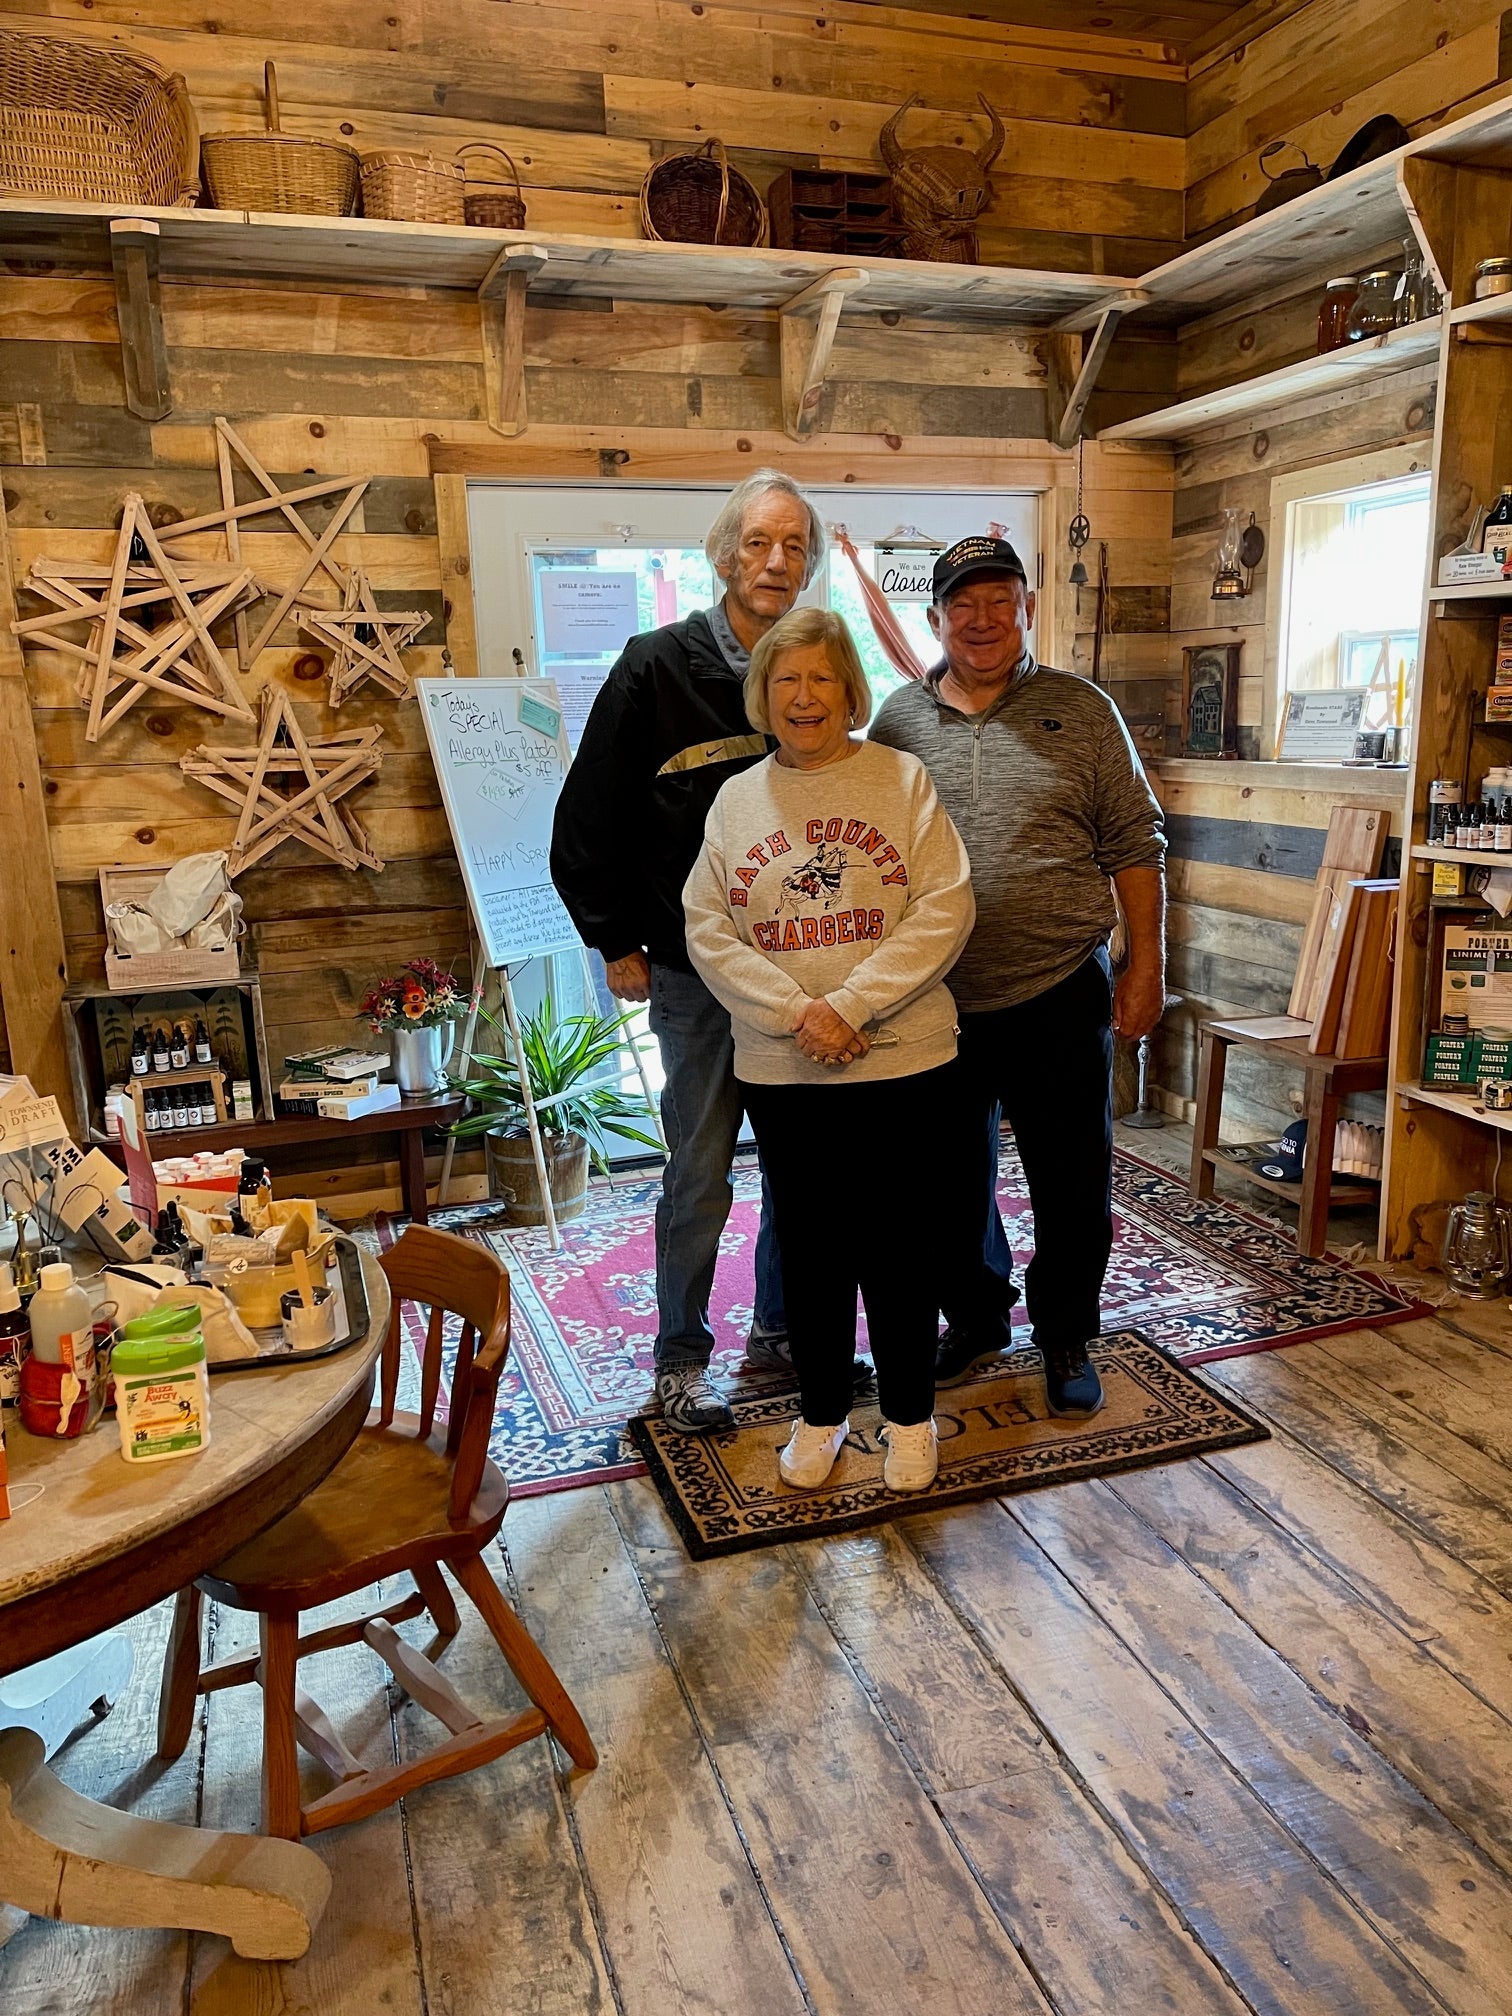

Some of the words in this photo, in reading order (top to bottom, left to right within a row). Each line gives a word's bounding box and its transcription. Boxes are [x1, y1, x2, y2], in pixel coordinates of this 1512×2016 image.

[946, 539, 996, 562] VIETNAM
[952, 551, 994, 567] VETERAN
[899, 563, 912, 571] We
[441, 691, 481, 714] Today's
[449, 707, 522, 735] SPECIAL
[449, 738, 496, 768] Allergy
[495, 739, 519, 760] Plus
[520, 736, 558, 763] Patch
[515, 763, 531, 777] $5
[536, 760, 552, 777] off
[1441, 804, 1450, 818] TEA
[471, 846, 516, 876] HAPPY
[730, 830, 792, 908] BATH
[806, 817, 909, 888] COUNTY
[753, 908, 886, 952] CHARGERS
[1467, 937, 1512, 949] PORTER
[1452, 951, 1501, 959] LINIMET
[1439, 1041, 1465, 1049] PORTER'S
[1482, 1043, 1509, 1052] PORTER'S
[1436, 1052, 1462, 1060] PORTER'S
[1481, 1054, 1508, 1063] PORTER'S
[1434, 1062, 1460, 1070] PORTER'S
[1478, 1065, 1504, 1073] PORTER'S
[1433, 1073, 1459, 1081] PORTER'S
[9, 1100, 54, 1117] TOWNSEND
[11, 1106, 57, 1126] DRAFT
